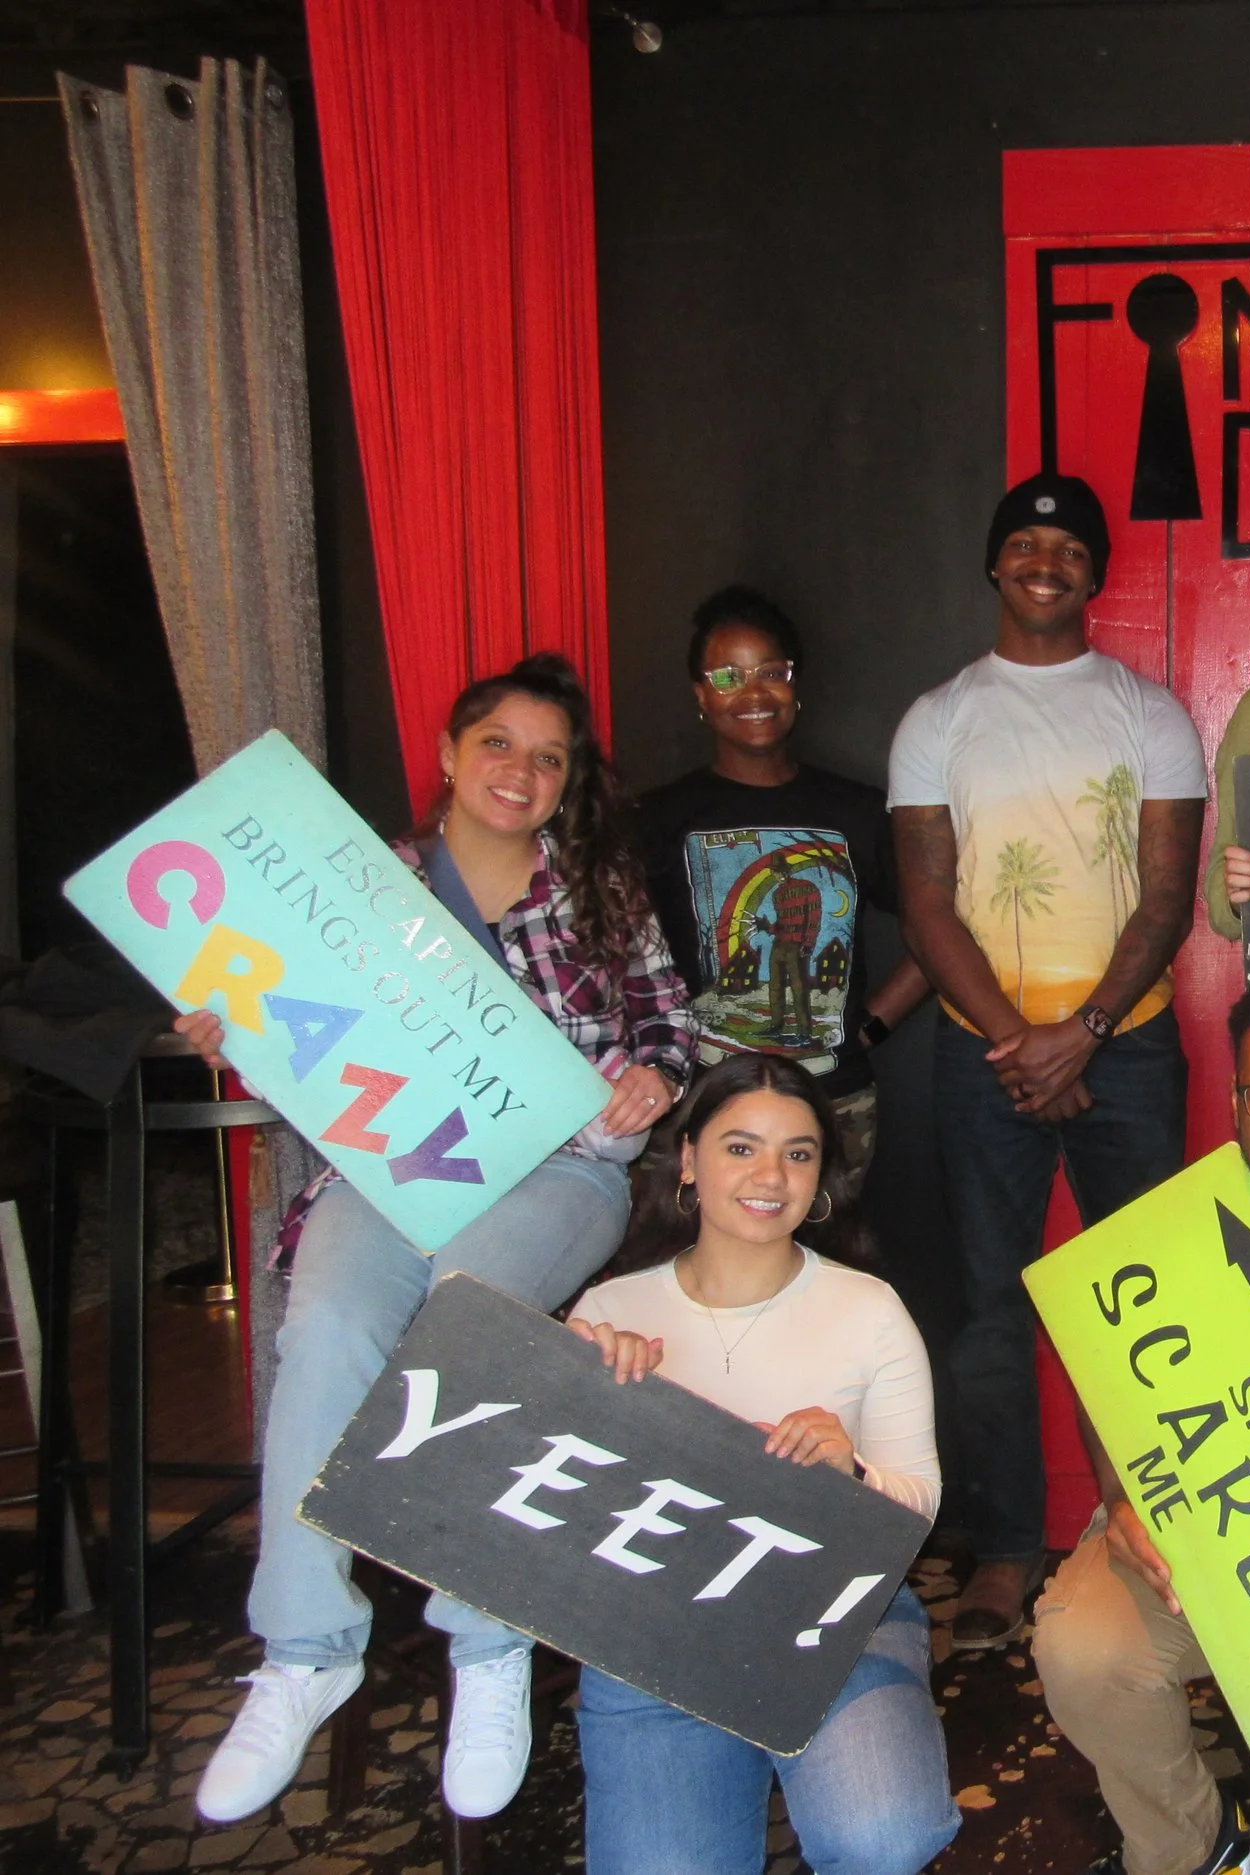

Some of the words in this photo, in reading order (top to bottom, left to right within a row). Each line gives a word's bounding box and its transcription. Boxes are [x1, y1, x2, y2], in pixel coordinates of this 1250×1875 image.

[324, 836, 519, 1038] ESCAPING
[713, 832, 736, 844] ELM
[125, 839, 487, 1187] CRAZY
[221, 812, 381, 974] BRINGS
[372, 970, 463, 1056] OUT
[452, 1054, 528, 1122] MY
[1126, 1445, 1193, 1534] ME
